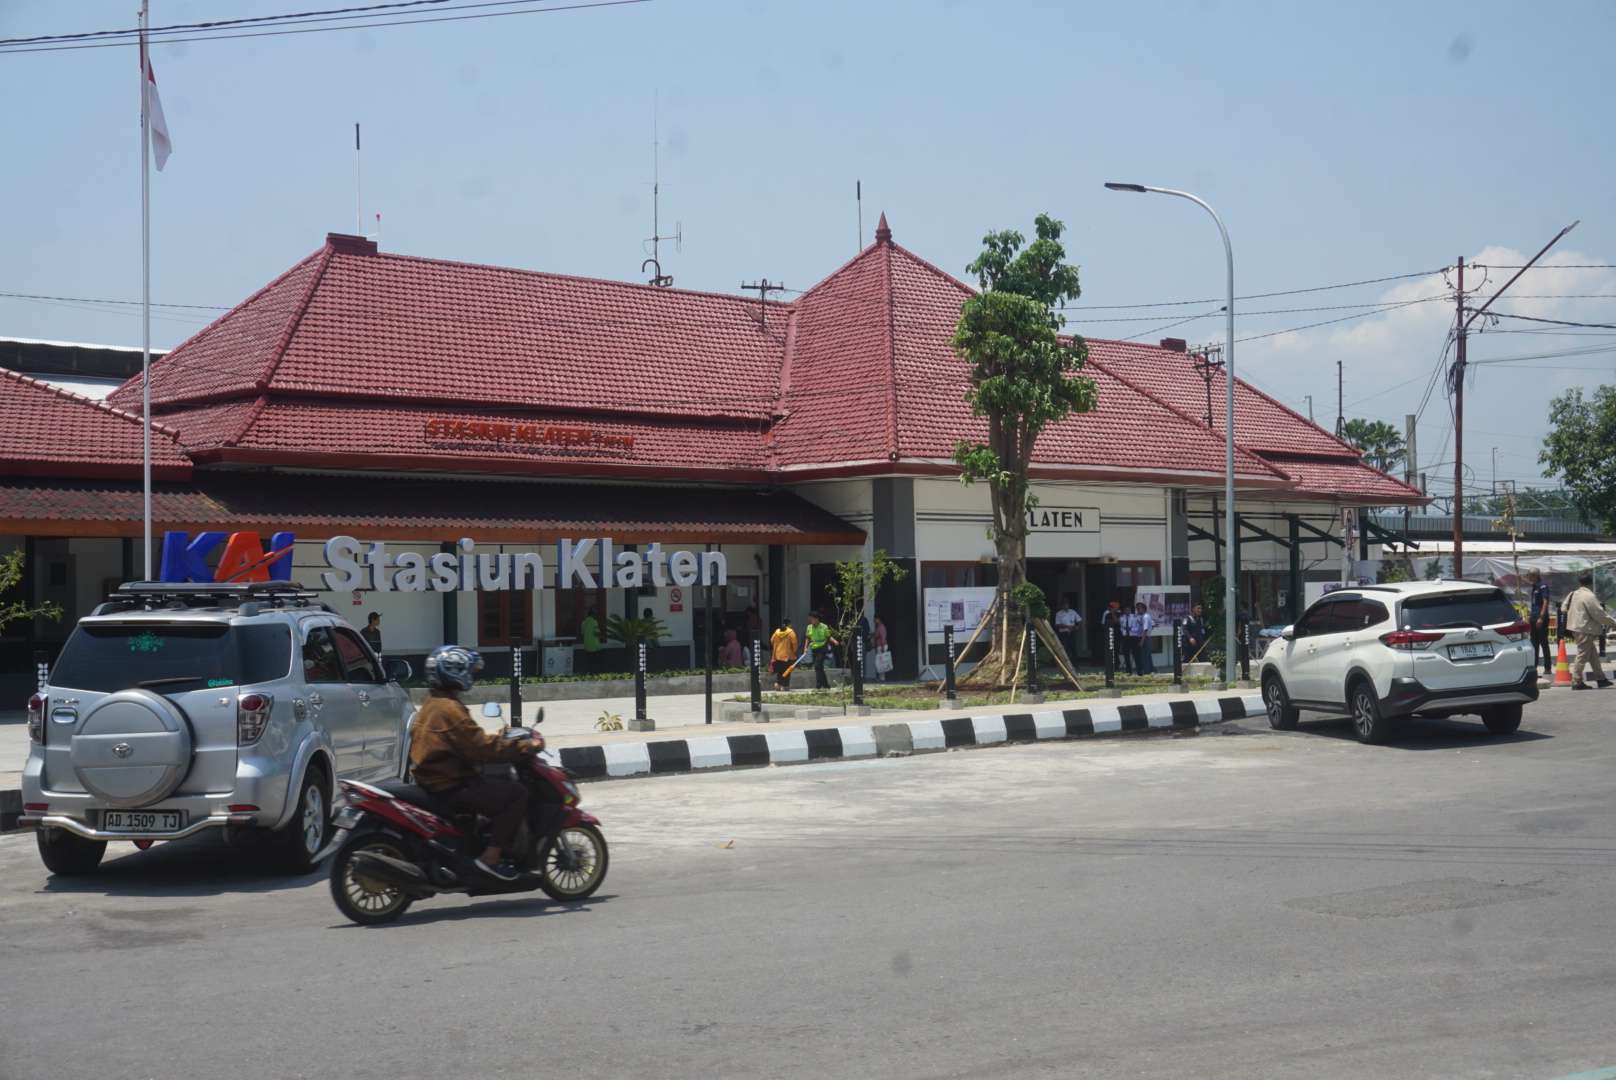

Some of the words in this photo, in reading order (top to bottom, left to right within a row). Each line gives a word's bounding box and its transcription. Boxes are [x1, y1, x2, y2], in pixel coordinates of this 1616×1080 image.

[427, 419, 512, 440] STASIUN
[516, 424, 591, 446] KLATEN
[1023, 510, 1083, 528] LATEN
[160, 531, 296, 583] KAI
[321, 535, 544, 593] Stasiun
[557, 537, 728, 589] Klaten
[1460, 645, 1477, 654] 1849
[1482, 644, 1491, 653] JS
[107, 813, 122, 827] AD
[126, 813, 156, 828] 1509
[162, 814, 177, 828] TJ
